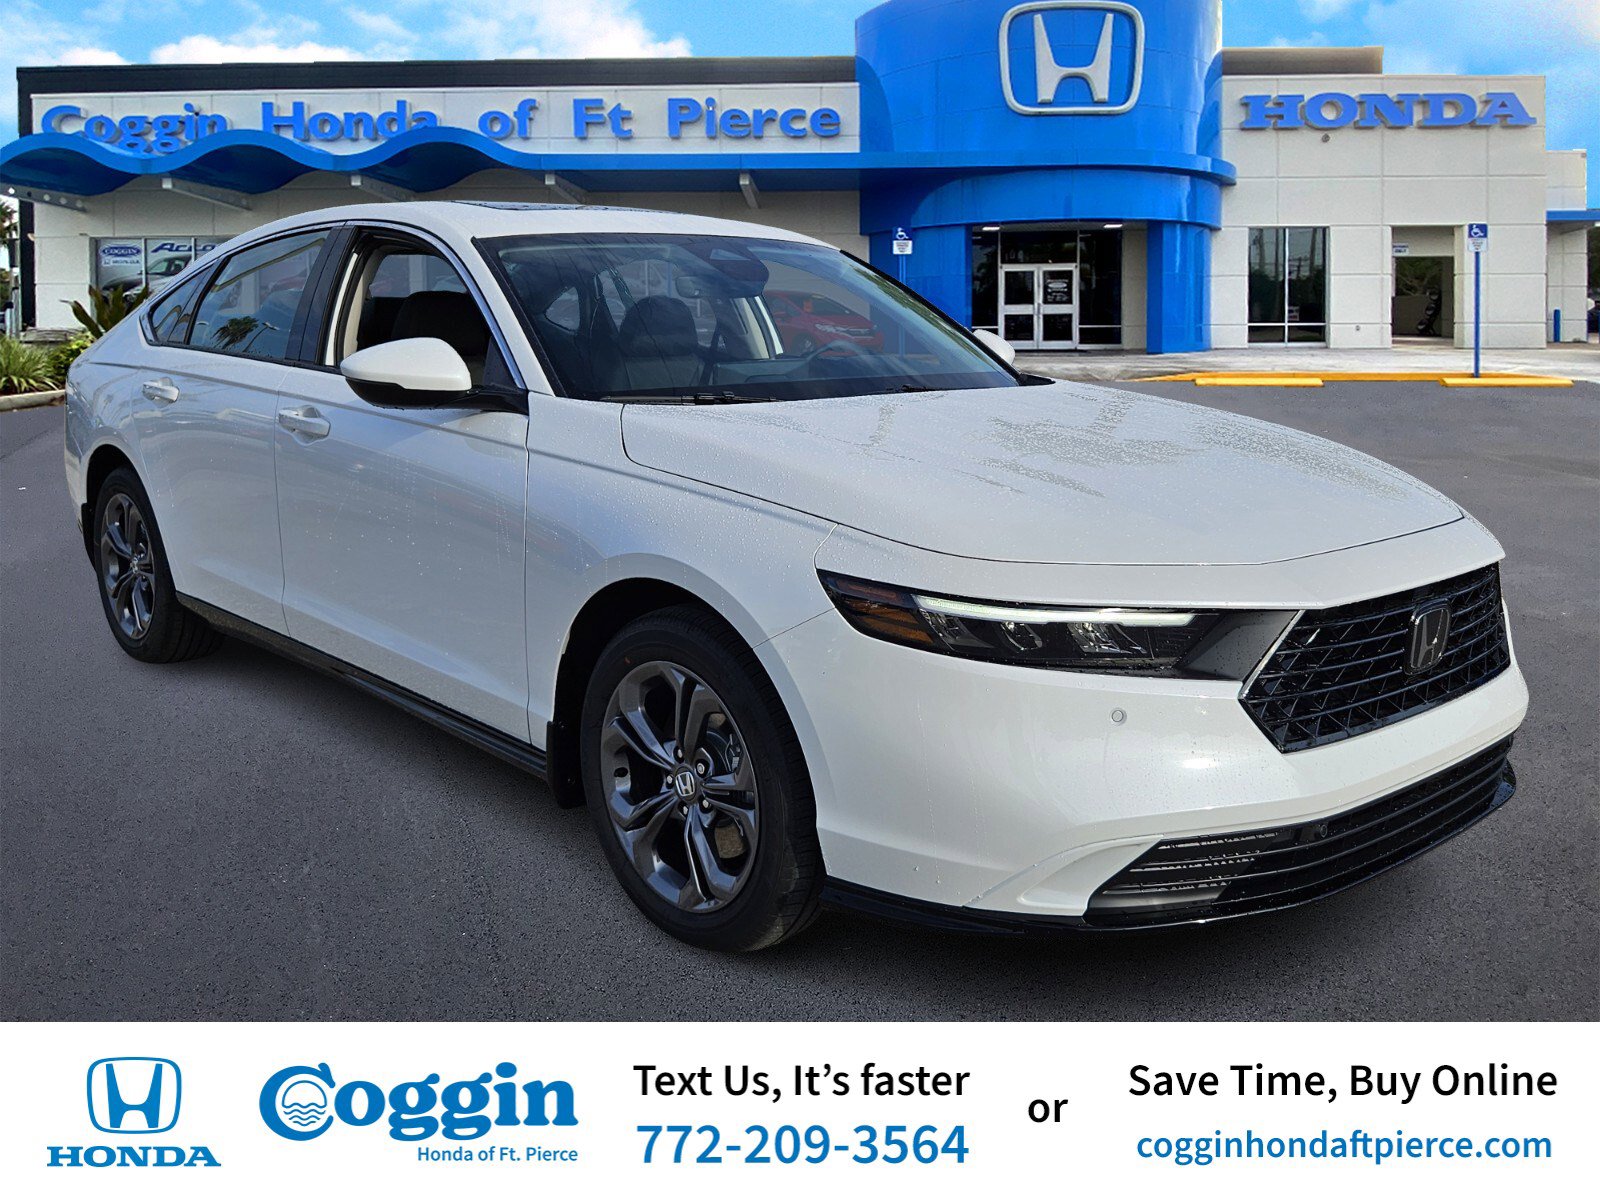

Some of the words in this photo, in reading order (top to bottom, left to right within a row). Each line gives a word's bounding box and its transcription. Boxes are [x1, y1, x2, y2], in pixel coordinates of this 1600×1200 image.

[41, 102, 228, 154] Coggin
[262, 100, 438, 140] Honda
[478, 98, 538, 140] of
[573, 98, 633, 139] Ft
[667, 97, 842, 138] Pierce
[1240, 92, 1537, 130] HONDA
